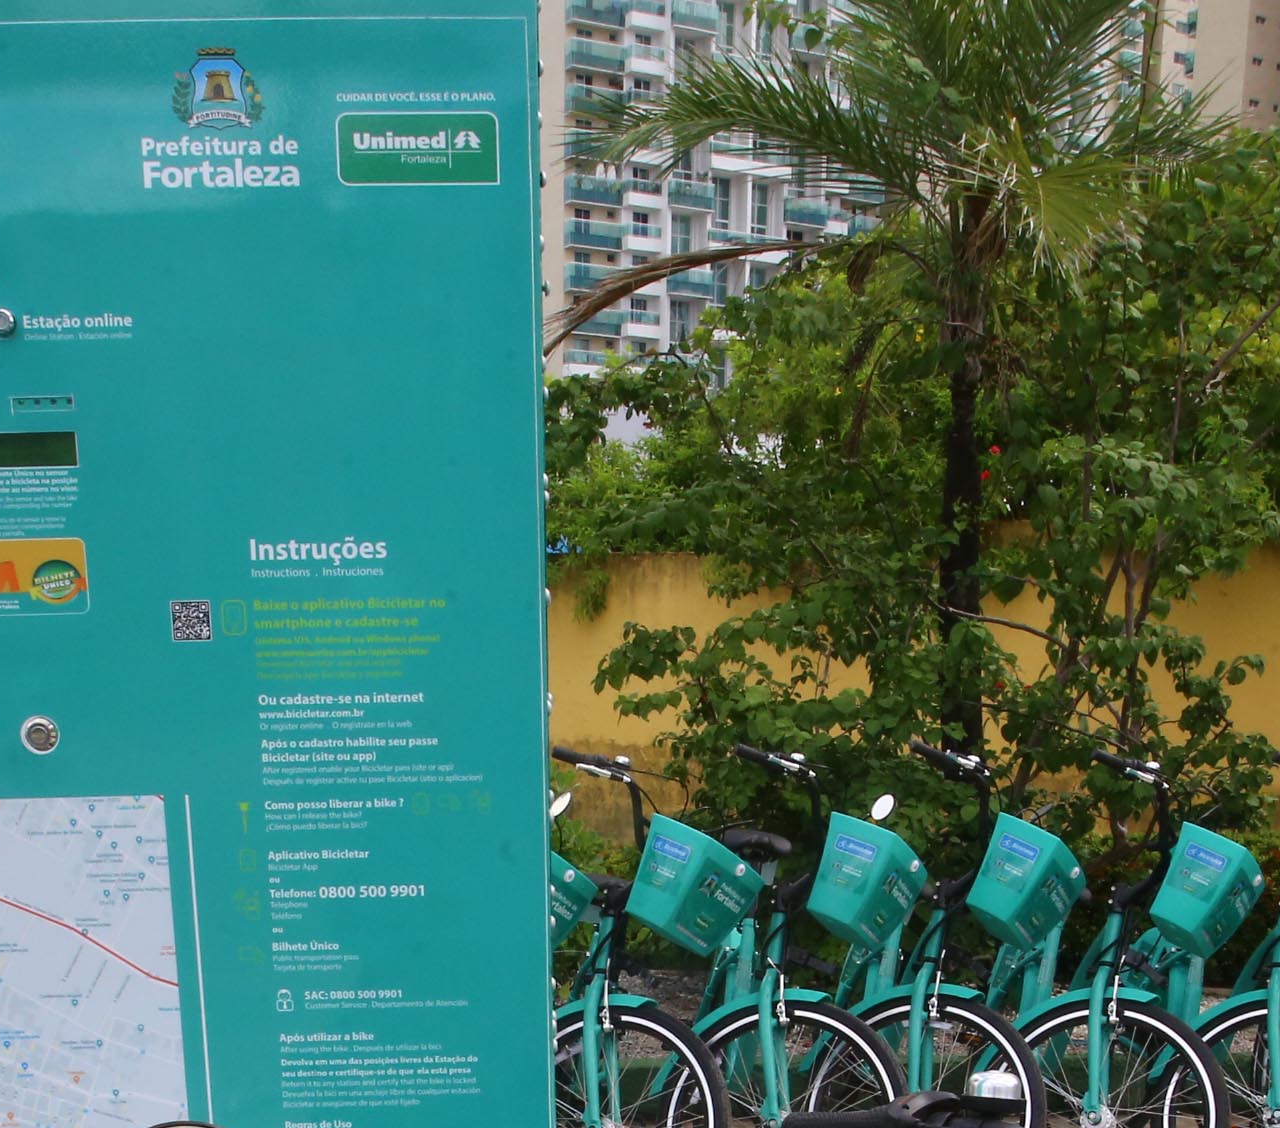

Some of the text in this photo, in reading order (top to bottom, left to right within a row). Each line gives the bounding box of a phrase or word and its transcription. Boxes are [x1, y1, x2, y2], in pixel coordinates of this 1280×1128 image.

[336, 93, 373, 102] CUIDAR
[375, 93, 388, 102] DE
[419, 93, 443, 102] ESSE
[444, 91, 450, 101] É
[451, 93, 459, 101] O
[460, 92, 496, 102] PLANO.
[141, 135, 298, 156] Prefeitura de
[353, 131, 446, 151] Unimed
[401, 154, 446, 164] Fortaleza
[143, 159, 300, 189] Fortaleza
[22, 313, 133, 334] Estação online
[249, 537, 387, 565] Instruções
[251, 566, 384, 578] Instructions Instruciones
[253, 597, 446, 612] Baixe o aplicativo Bicicletar no
[254, 615, 418, 632] smartphone e cadastre-se
[258, 692, 423, 706] Ou cadastre-se na internet
[259, 709, 364, 719] www.bicicletar.com.br
[261, 737, 438, 750] Após o cadastro habilite seu passe
[262, 751, 377, 763] Bicicletar (site ou app)
[265, 801, 295, 810] Como
[297, 801, 328, 811] posso
[330, 799, 364, 808] liberar
[366, 800, 372, 808] a
[374, 799, 397, 808] bike
[268, 850, 369, 861] Aplicativo Bicicletar
[269, 876, 280, 884] ou
[270, 884, 425, 899] Telefone: 0800 500 9901
[272, 926, 283, 934] ou
[272, 940, 339, 951] Bilhete Único
[304, 989, 402, 1000] SAC: 0800 500 9901
[280, 1033, 305, 1044] Após
[307, 1033, 342, 1042] utilizar
[352, 1032, 374, 1041] bike
[320, 1120, 332, 1128] de
[334, 1120, 352, 1128] Uso
